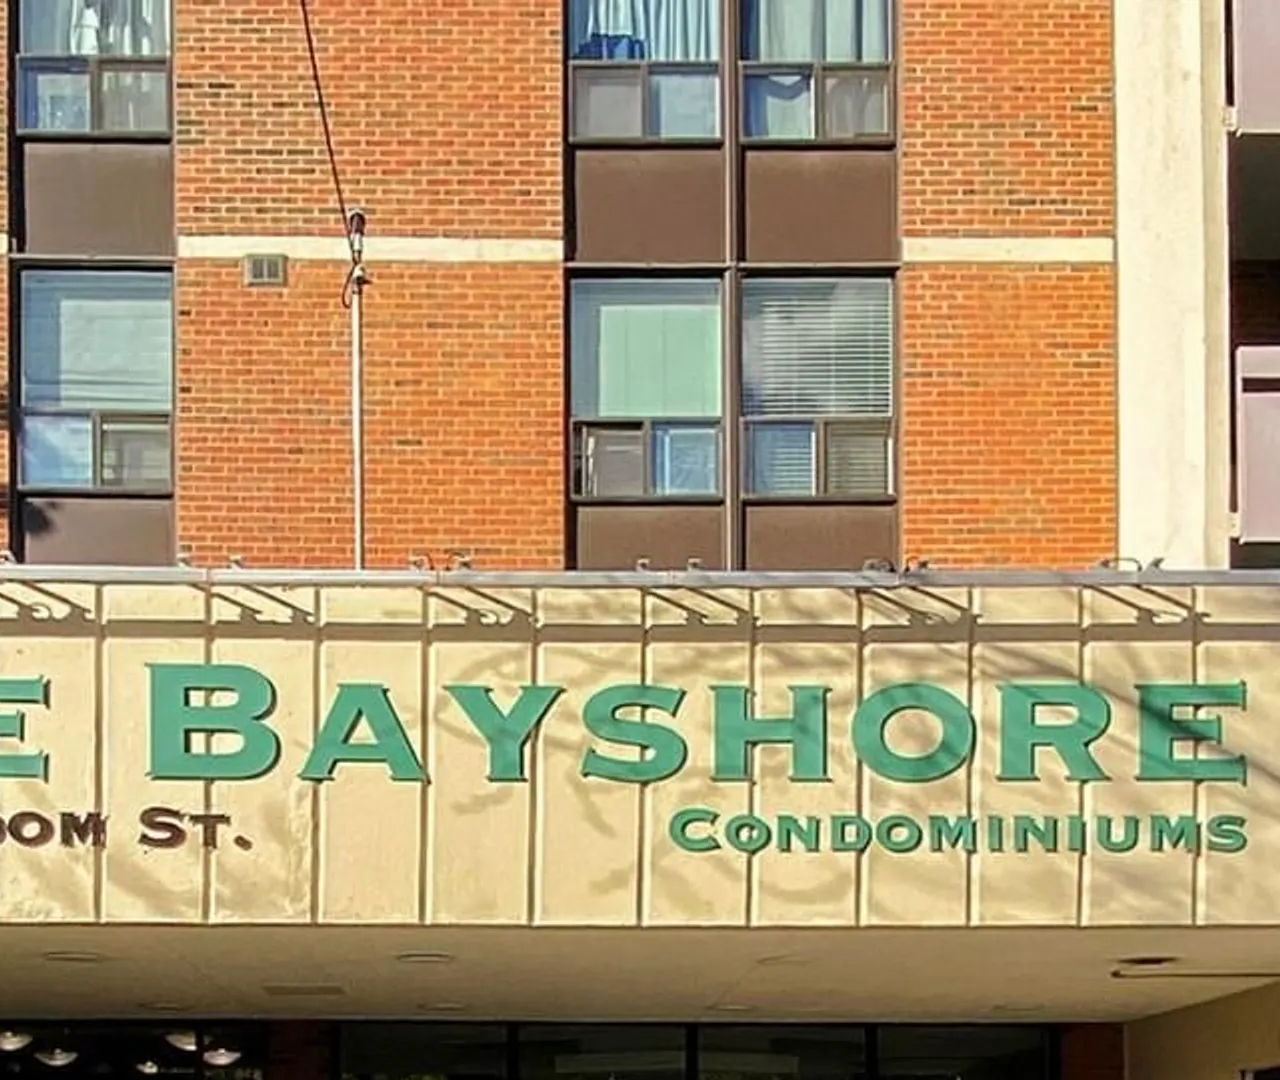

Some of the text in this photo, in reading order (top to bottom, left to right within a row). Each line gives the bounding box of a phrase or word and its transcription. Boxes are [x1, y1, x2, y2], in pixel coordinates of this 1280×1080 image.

[146, 662, 1247, 786] BAYSHORE
[138, 807, 254, 851] ST.
[669, 807, 1248, 854] CONDOMINIUMS
